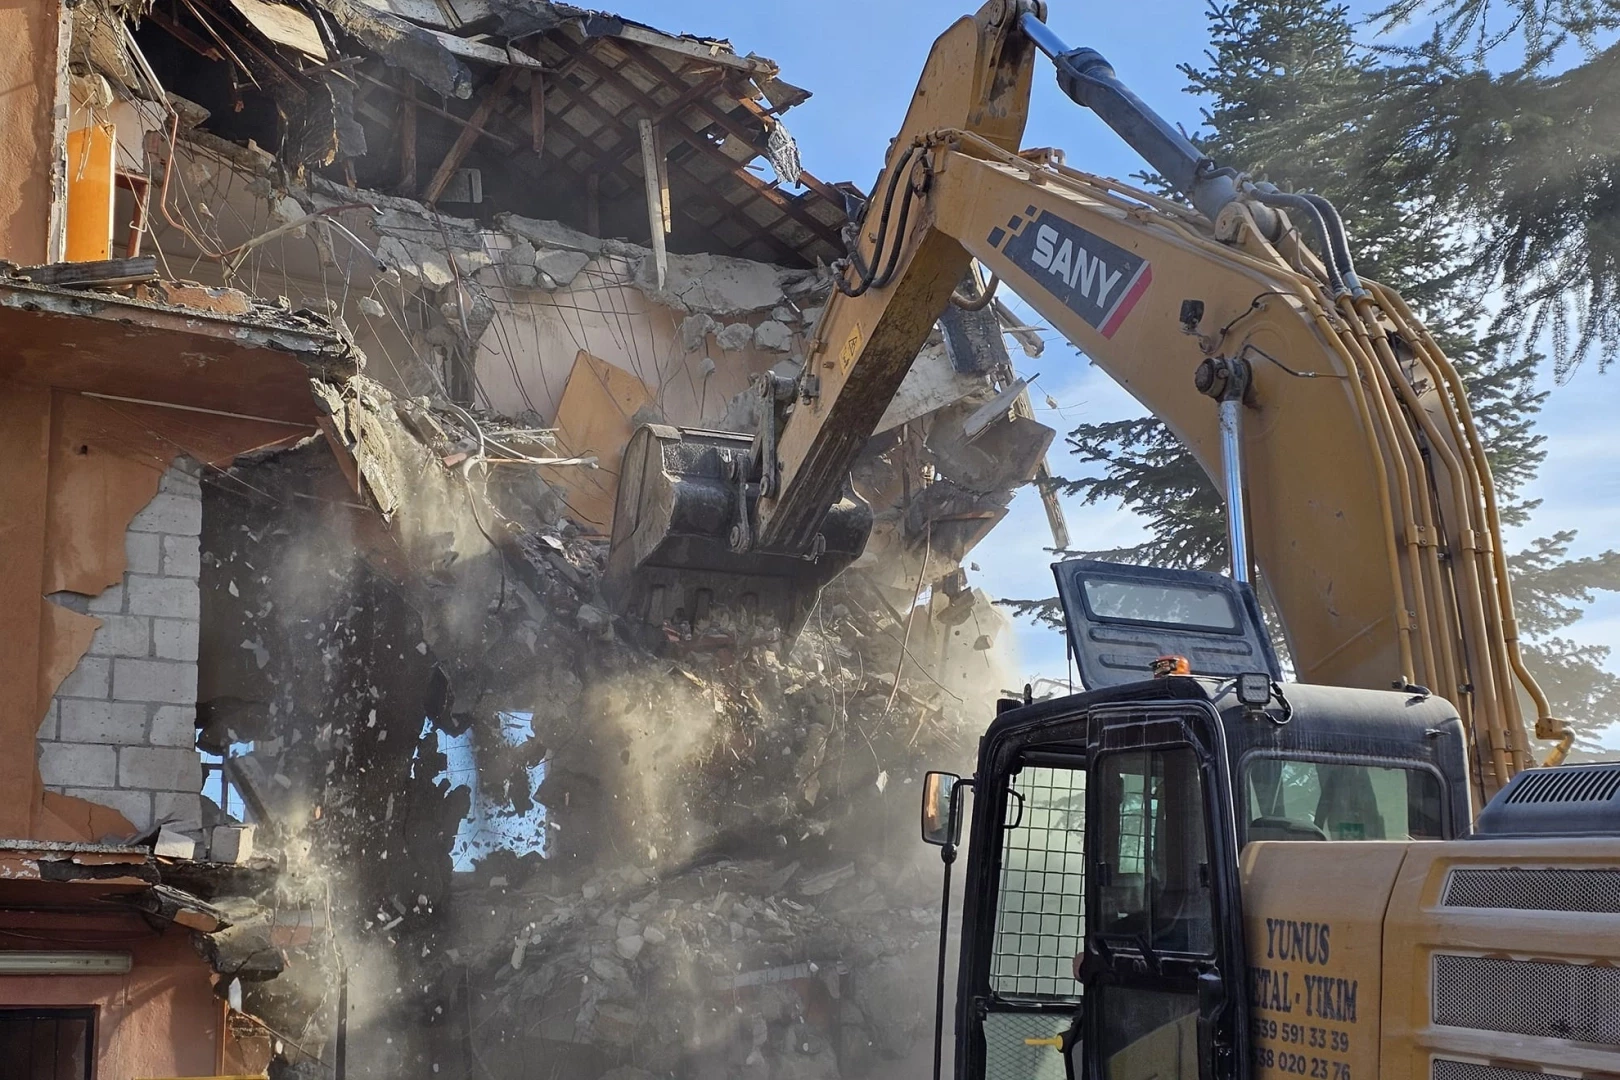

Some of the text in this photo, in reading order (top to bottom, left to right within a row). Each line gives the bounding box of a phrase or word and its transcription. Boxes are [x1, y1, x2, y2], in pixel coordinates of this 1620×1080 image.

[1031, 224, 1122, 308] SANY
[1266, 918, 1330, 966] YUNUS
[1251, 967, 1292, 1013] ETAL
[1304, 974, 1358, 1024] YIKIM
[1282, 1022, 1305, 1045] 591
[1309, 1027, 1326, 1049] 33
[1331, 1031, 1349, 1053] 39
[1254, 1048, 1351, 1080] 38 020 23 76
